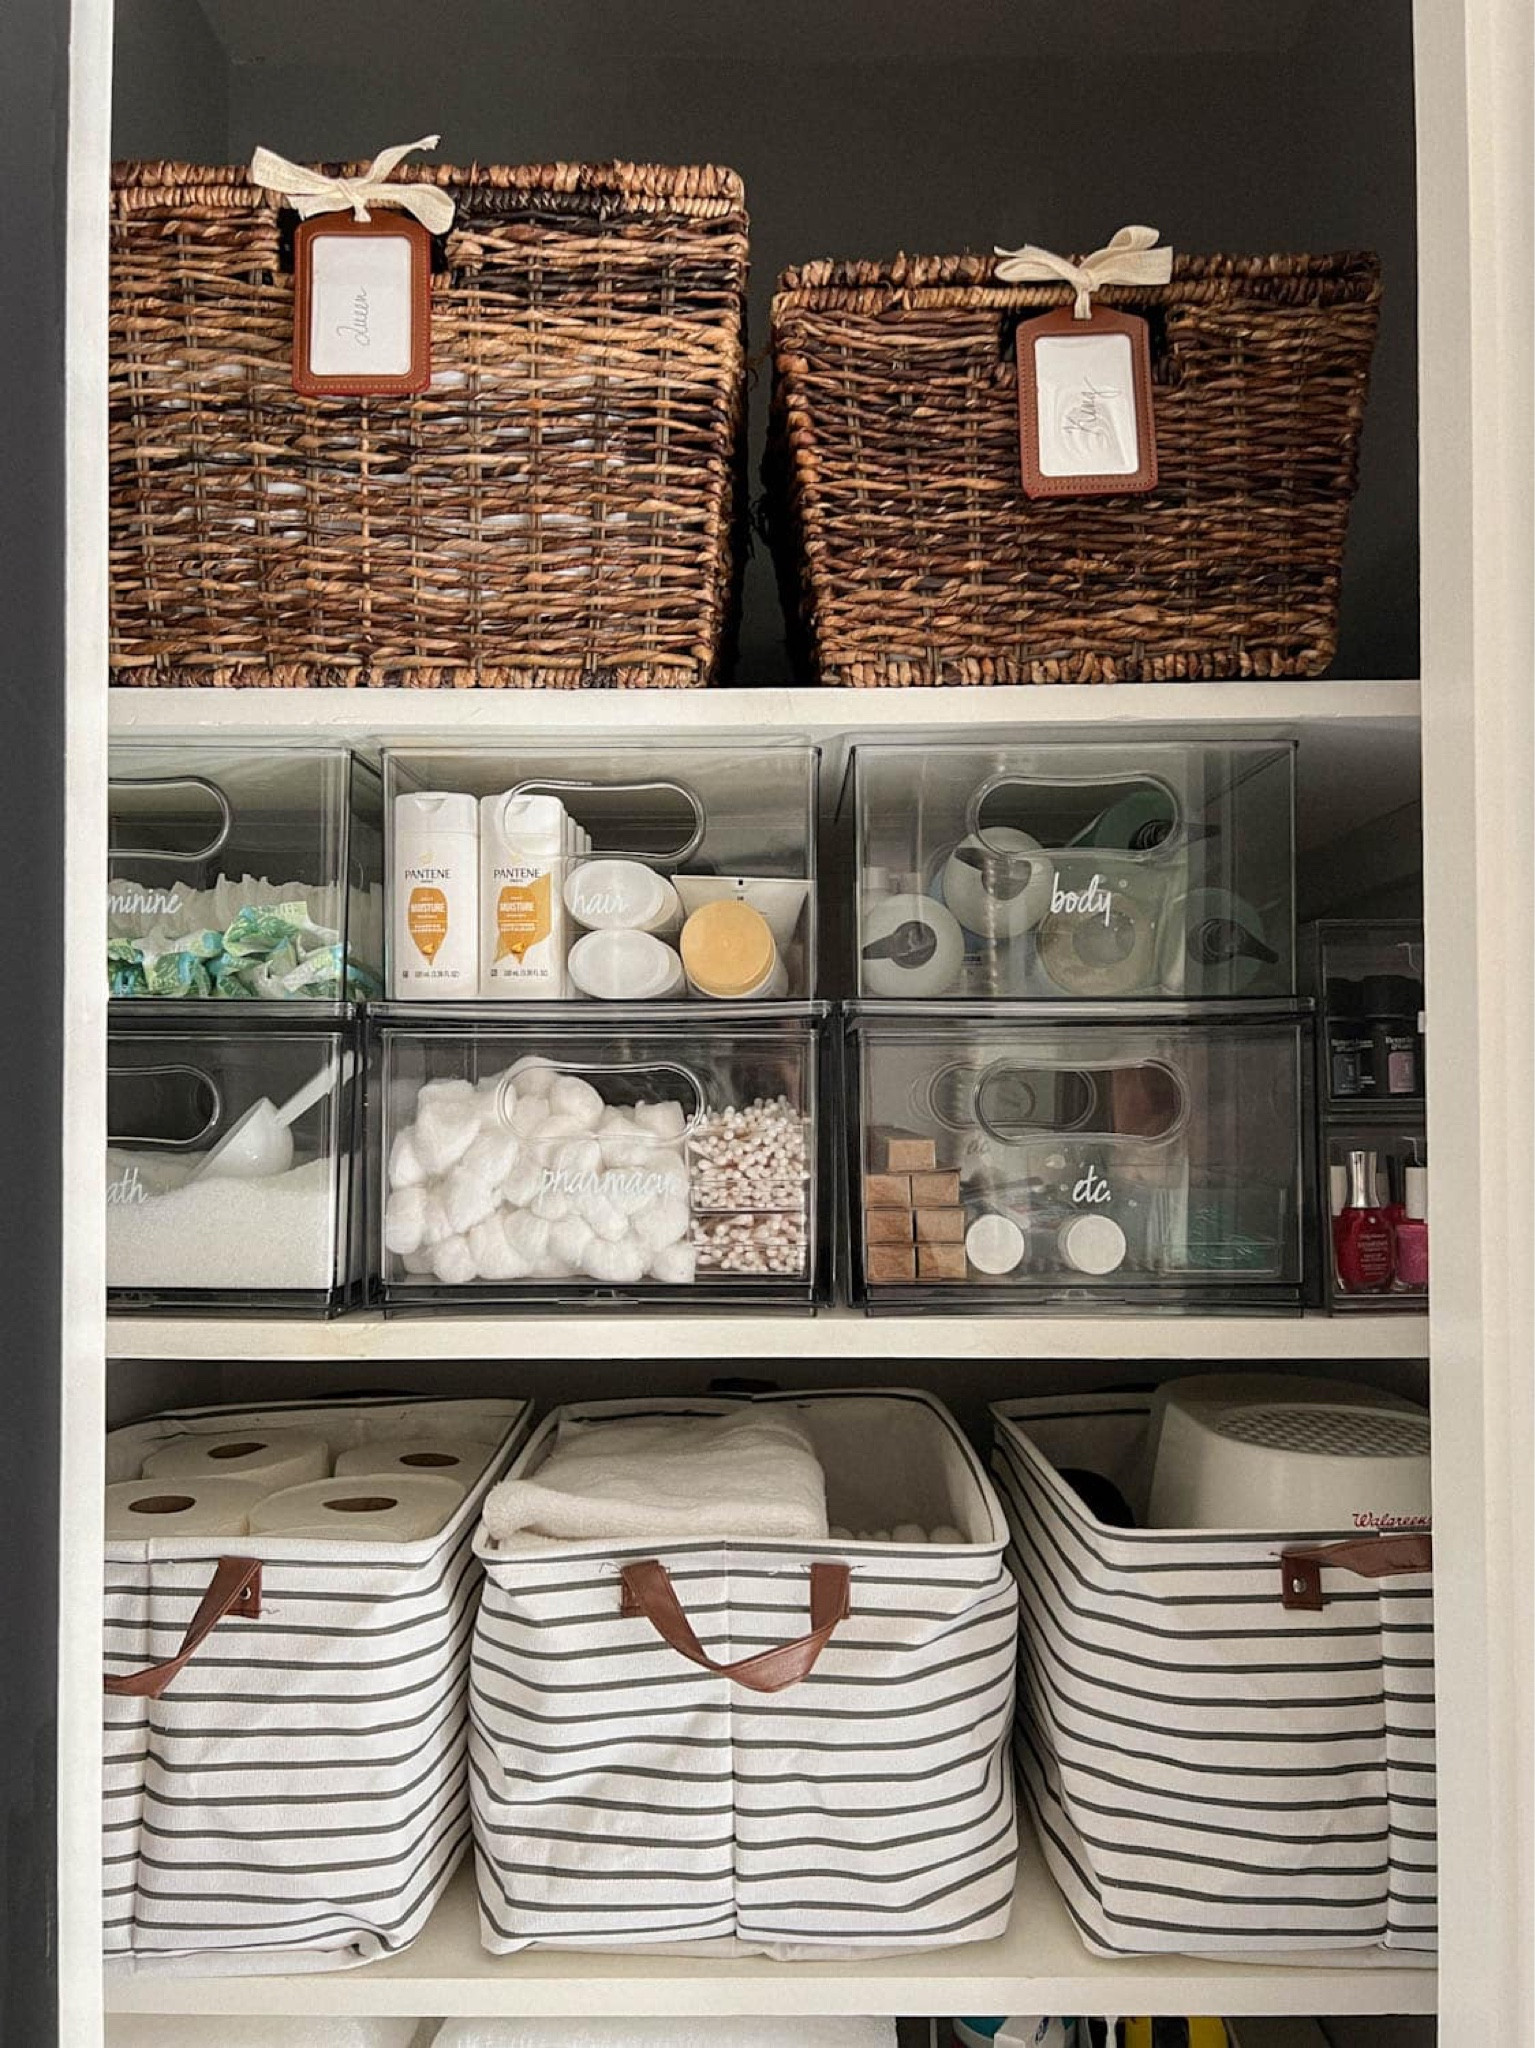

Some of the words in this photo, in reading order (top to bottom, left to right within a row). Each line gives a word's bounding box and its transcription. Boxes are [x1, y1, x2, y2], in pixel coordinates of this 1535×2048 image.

[405, 869, 451, 879] PANTENE
[493, 868, 540, 878] PANTENE
[571, 877, 629, 914] hair
[1050, 871, 1112, 927] body
[1072, 1164, 1111, 1202] etc.
